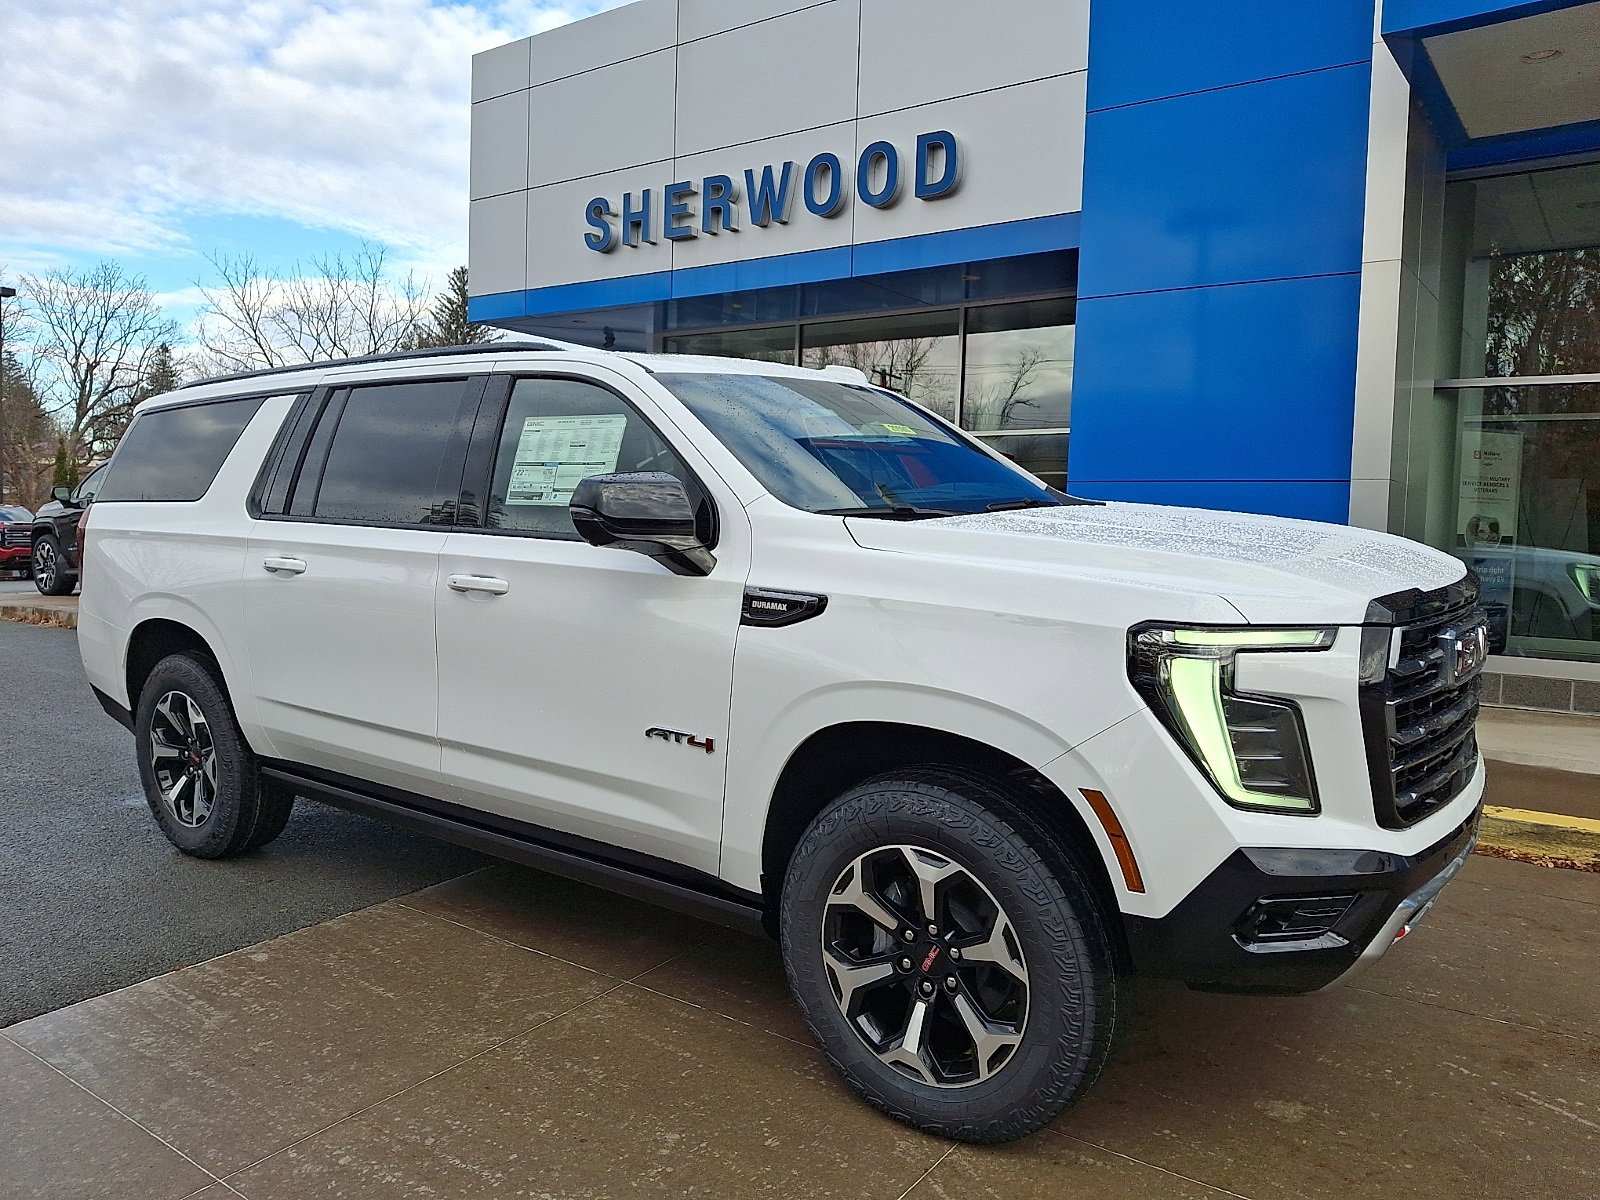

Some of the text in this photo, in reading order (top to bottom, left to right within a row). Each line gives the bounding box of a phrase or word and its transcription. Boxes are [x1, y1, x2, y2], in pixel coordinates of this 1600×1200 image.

[584, 130, 961, 253] SHERWOOD
[1488, 566, 1504, 575] right
[751, 600, 788, 611] DURAMAX
[645, 727, 715, 754] AT4
[921, 944, 940, 972] GMC
